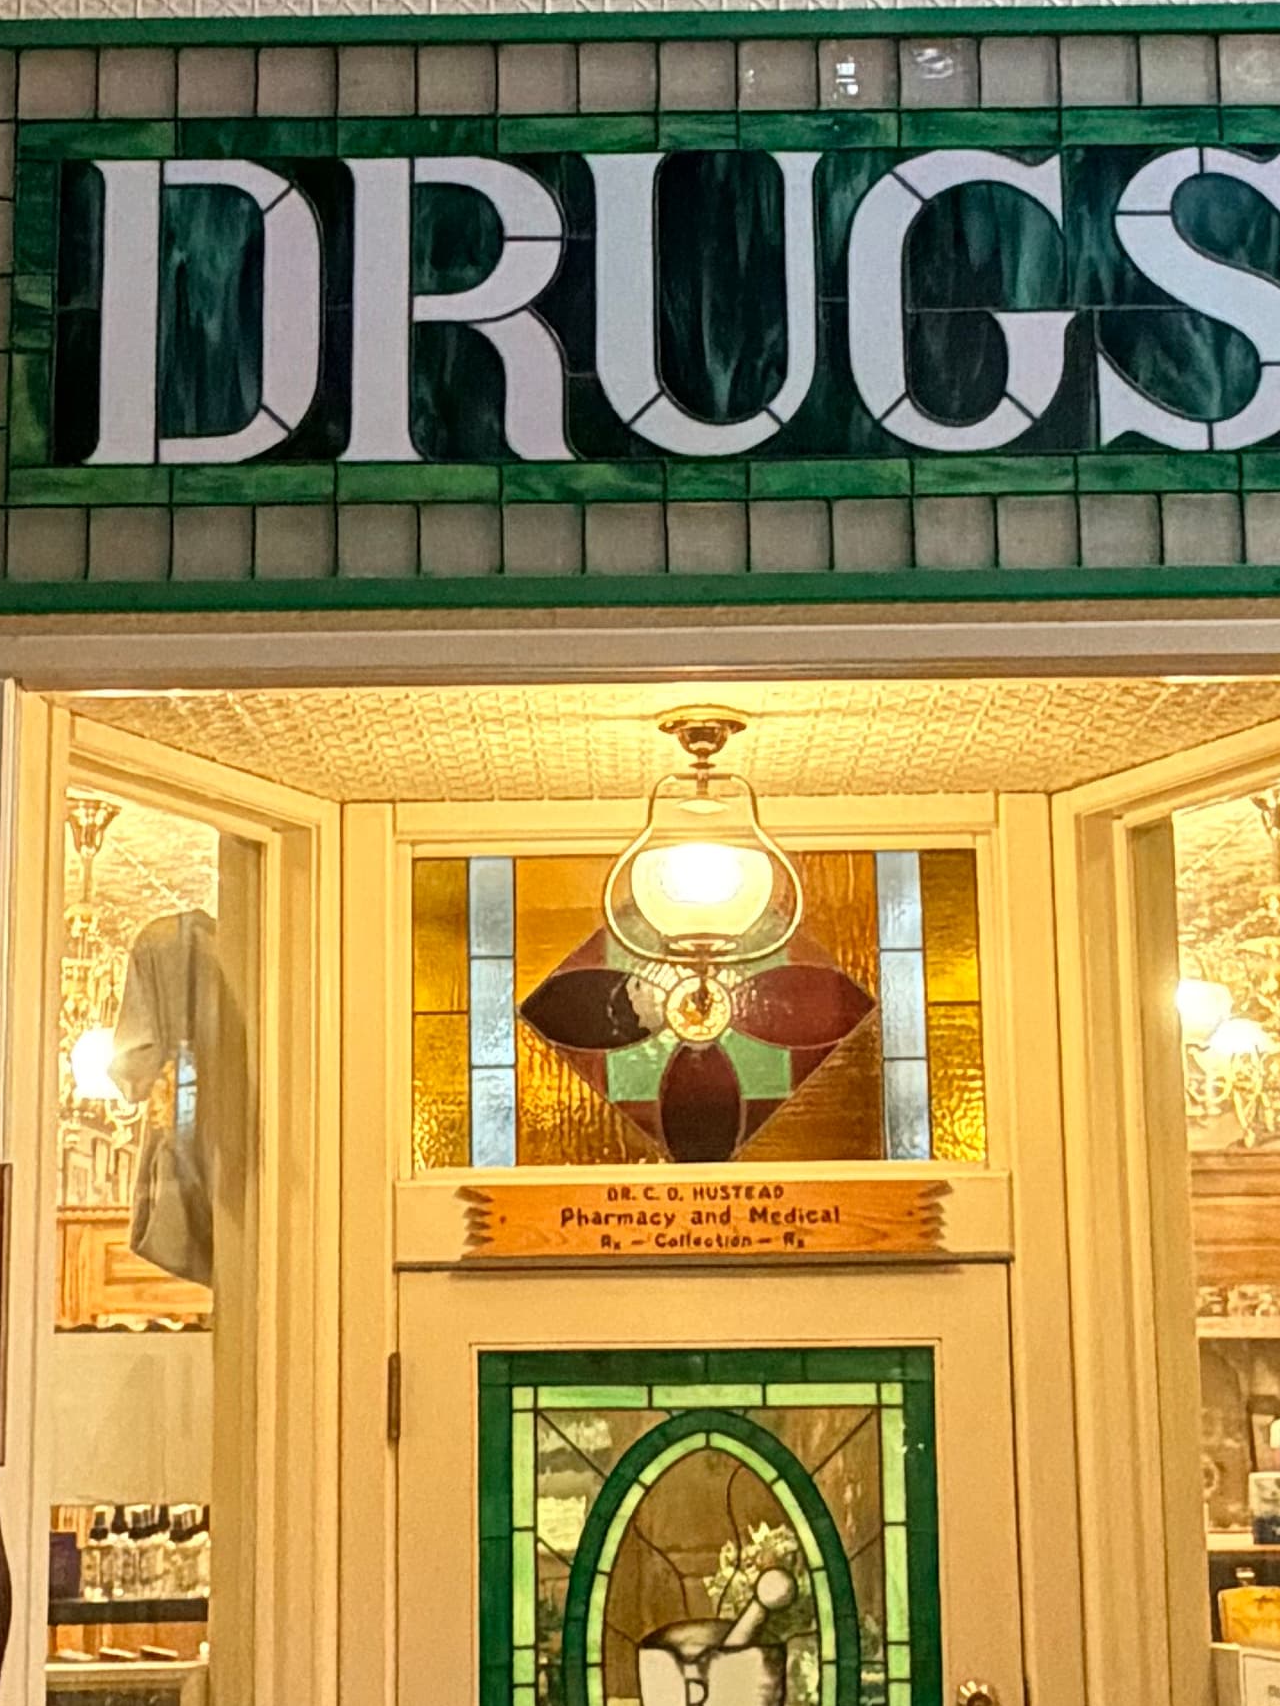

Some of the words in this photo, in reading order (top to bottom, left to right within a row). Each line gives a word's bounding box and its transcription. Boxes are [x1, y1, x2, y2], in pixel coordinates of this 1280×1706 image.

[606, 1186, 637, 1202] DR.
[692, 1184, 785, 1201] HUSTEAD
[560, 1207, 676, 1228] Pharmacy
[690, 1205, 732, 1226] and
[748, 1205, 841, 1226] Medical
[654, 1231, 753, 1249] Collection
